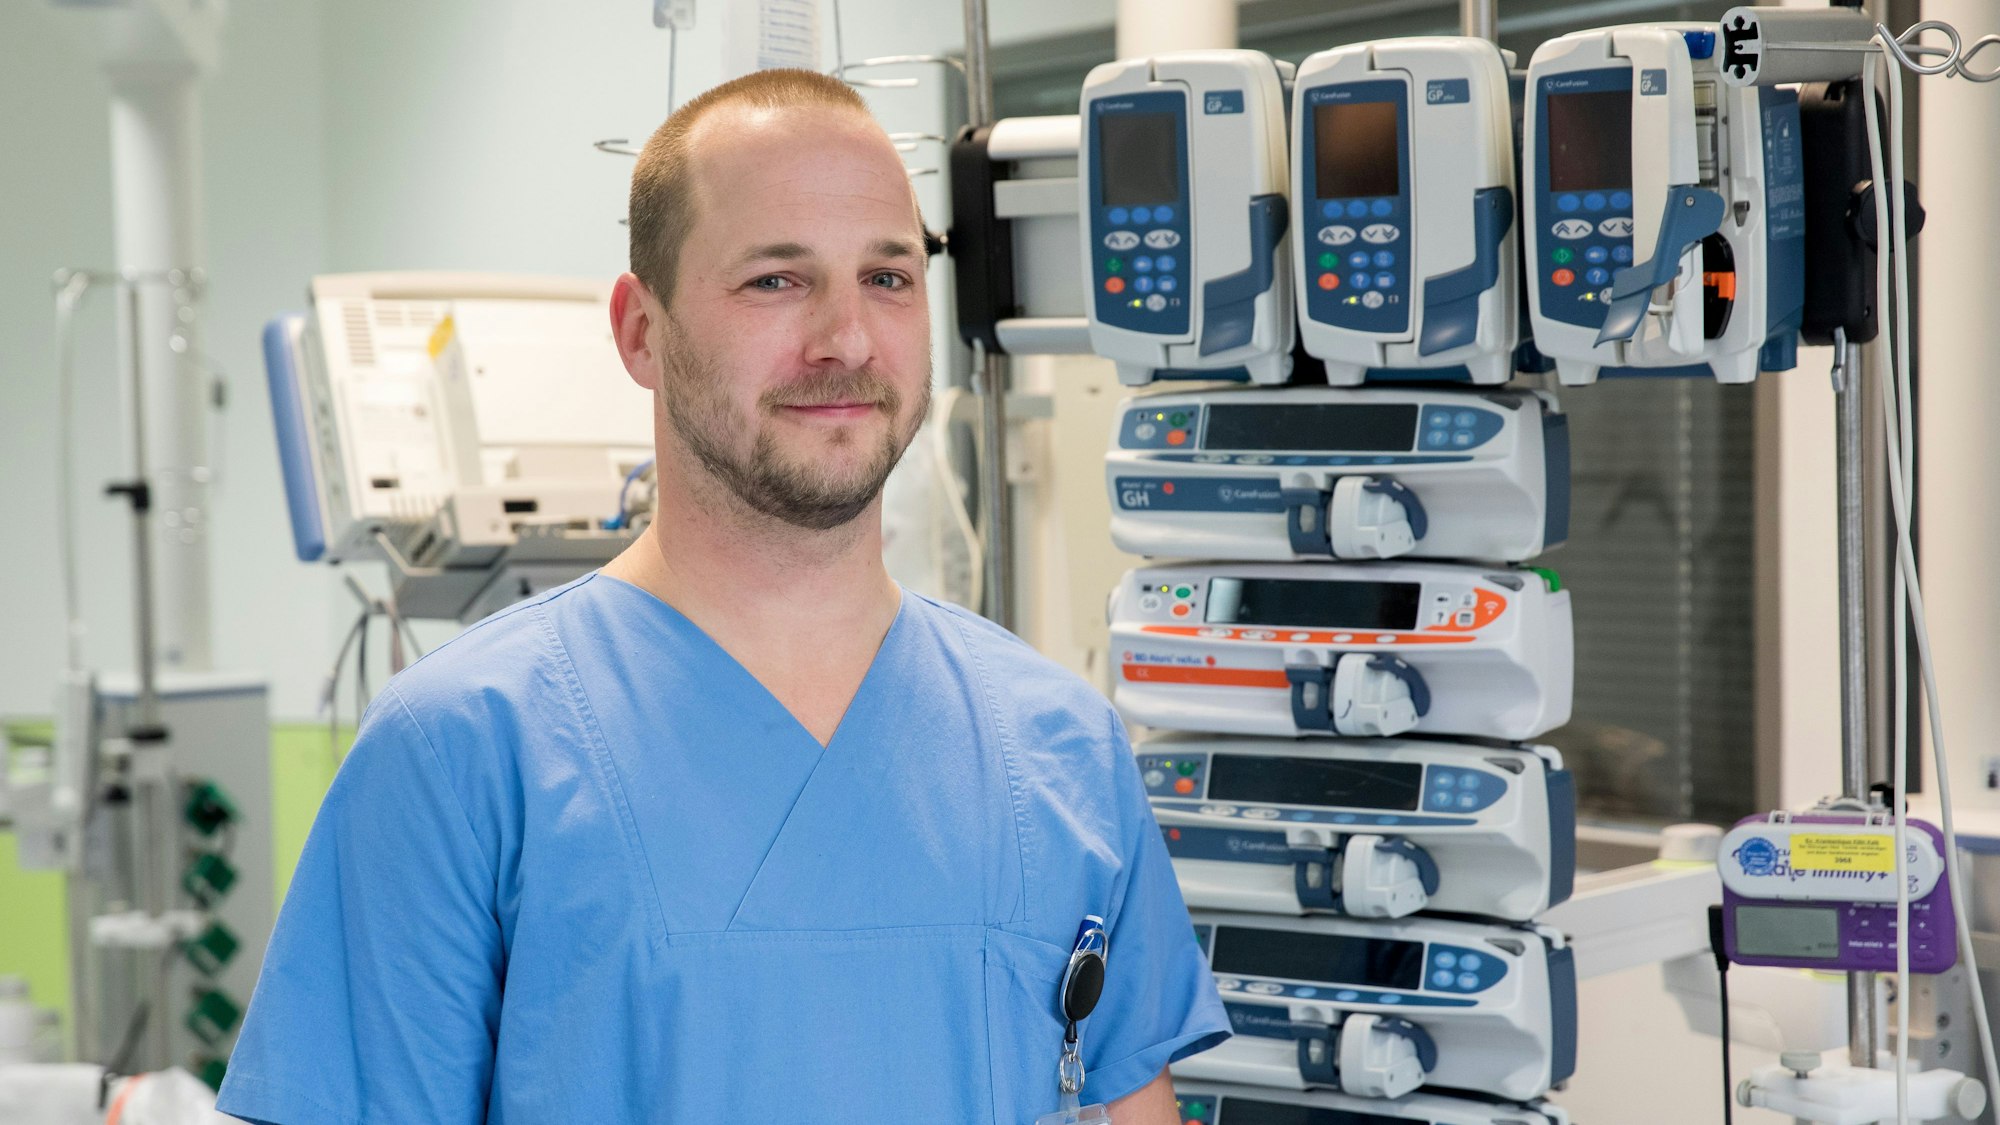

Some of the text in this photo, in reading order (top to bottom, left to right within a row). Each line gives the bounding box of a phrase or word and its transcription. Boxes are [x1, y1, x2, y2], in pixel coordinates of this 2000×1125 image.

[1555, 80, 1589, 89] CareFusion
[1641, 80, 1652, 92] GP
[1320, 91, 1351, 100] CareFusion
[1428, 89, 1443, 101] GP
[1104, 102, 1134, 110] CareFusion
[1206, 101, 1222, 112] GP
[1121, 490, 1150, 507] GH
[1233, 488, 1281, 499] CareFusion
